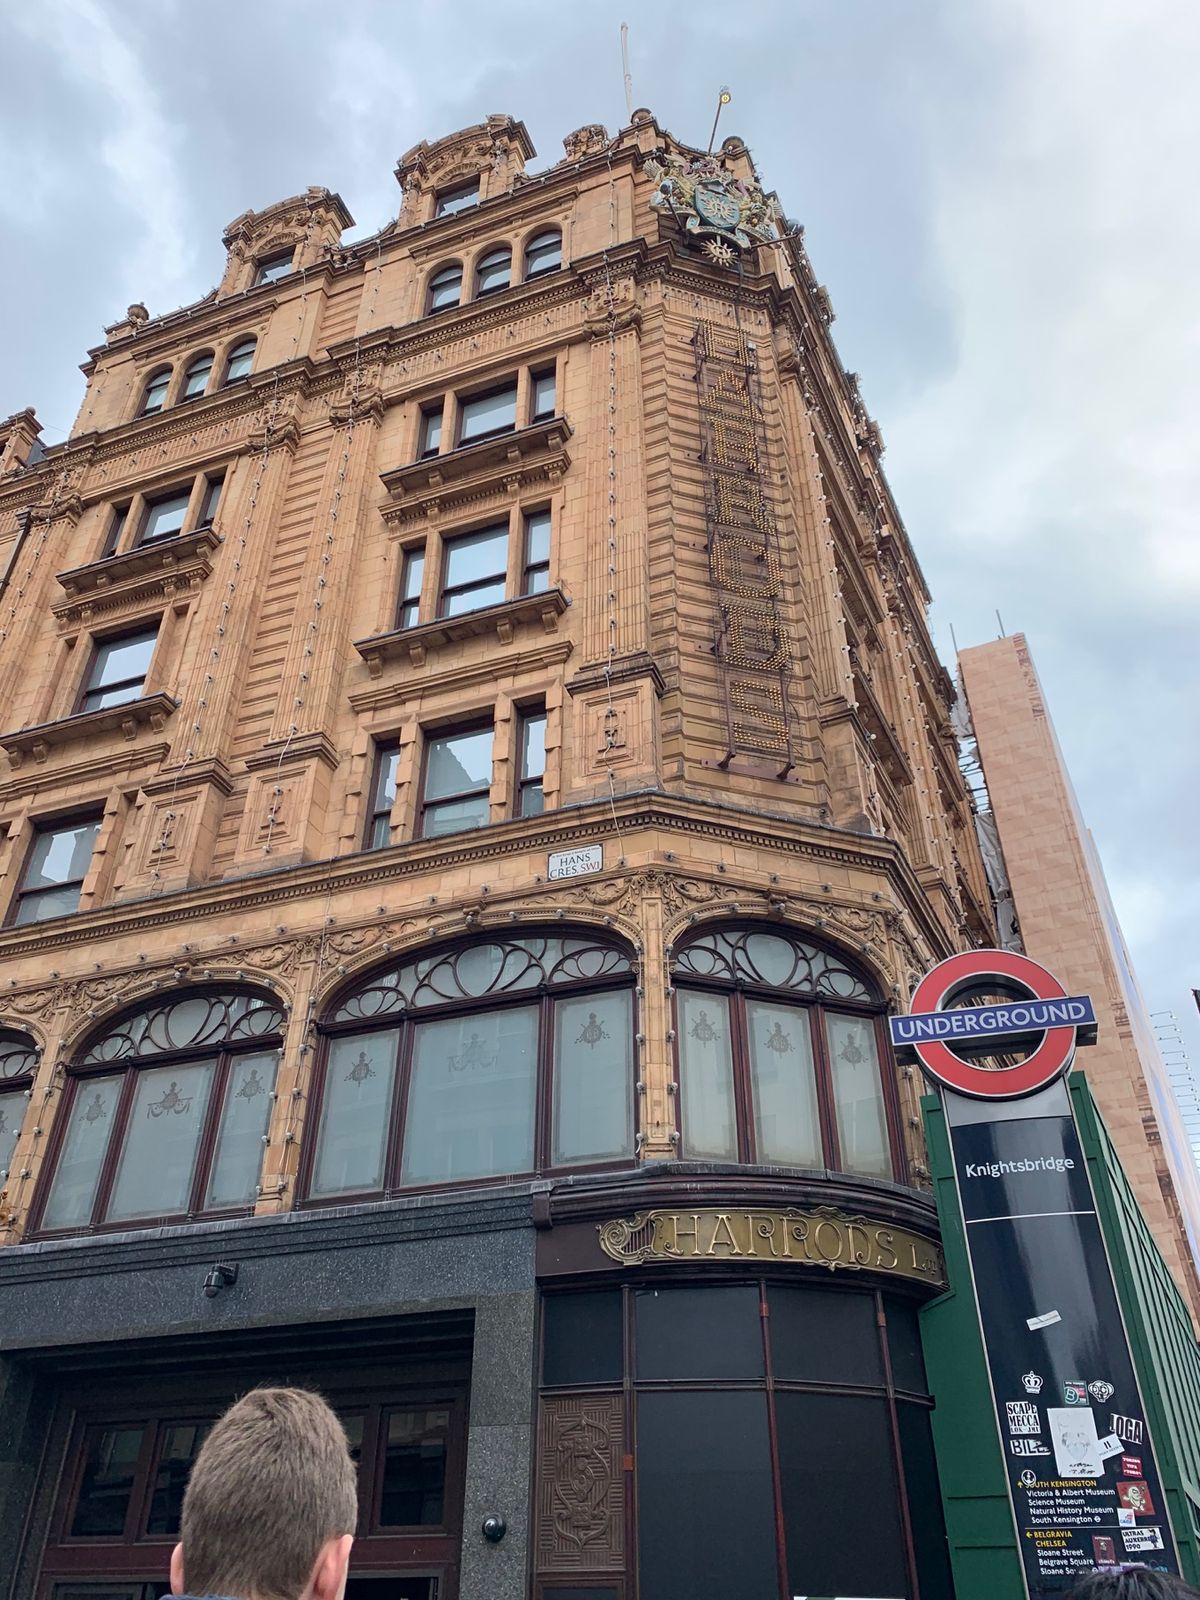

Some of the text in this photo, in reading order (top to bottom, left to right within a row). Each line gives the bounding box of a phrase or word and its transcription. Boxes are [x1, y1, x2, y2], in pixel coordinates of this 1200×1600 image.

[699, 317, 792, 749] HARRODS
[560, 852, 591, 867] HANS
[550, 865, 579, 879] CRES.
[898, 1003, 1086, 1038] UNDERGROUND
[965, 1156, 1075, 1178] Knightsbridge
[663, 1213, 898, 1269] HARRODS
[1009, 1414, 1040, 1426] MECCA
[1051, 1480, 1097, 1488] KENSINGTON
[1026, 1488, 1115, 1497] Victoria & Albert Museum
[1030, 1506, 1114, 1515] Natural History Museum
[1031, 1515, 1093, 1524] South Kensington
[1035, 1540, 1067, 1548] CHELSEA
[1037, 1549, 1061, 1557] Sloane
[1039, 1558, 1069, 1567] Belgrave
[1070, 1558, 1094, 1567] Square
[1040, 1567, 1064, 1575] Sloane
